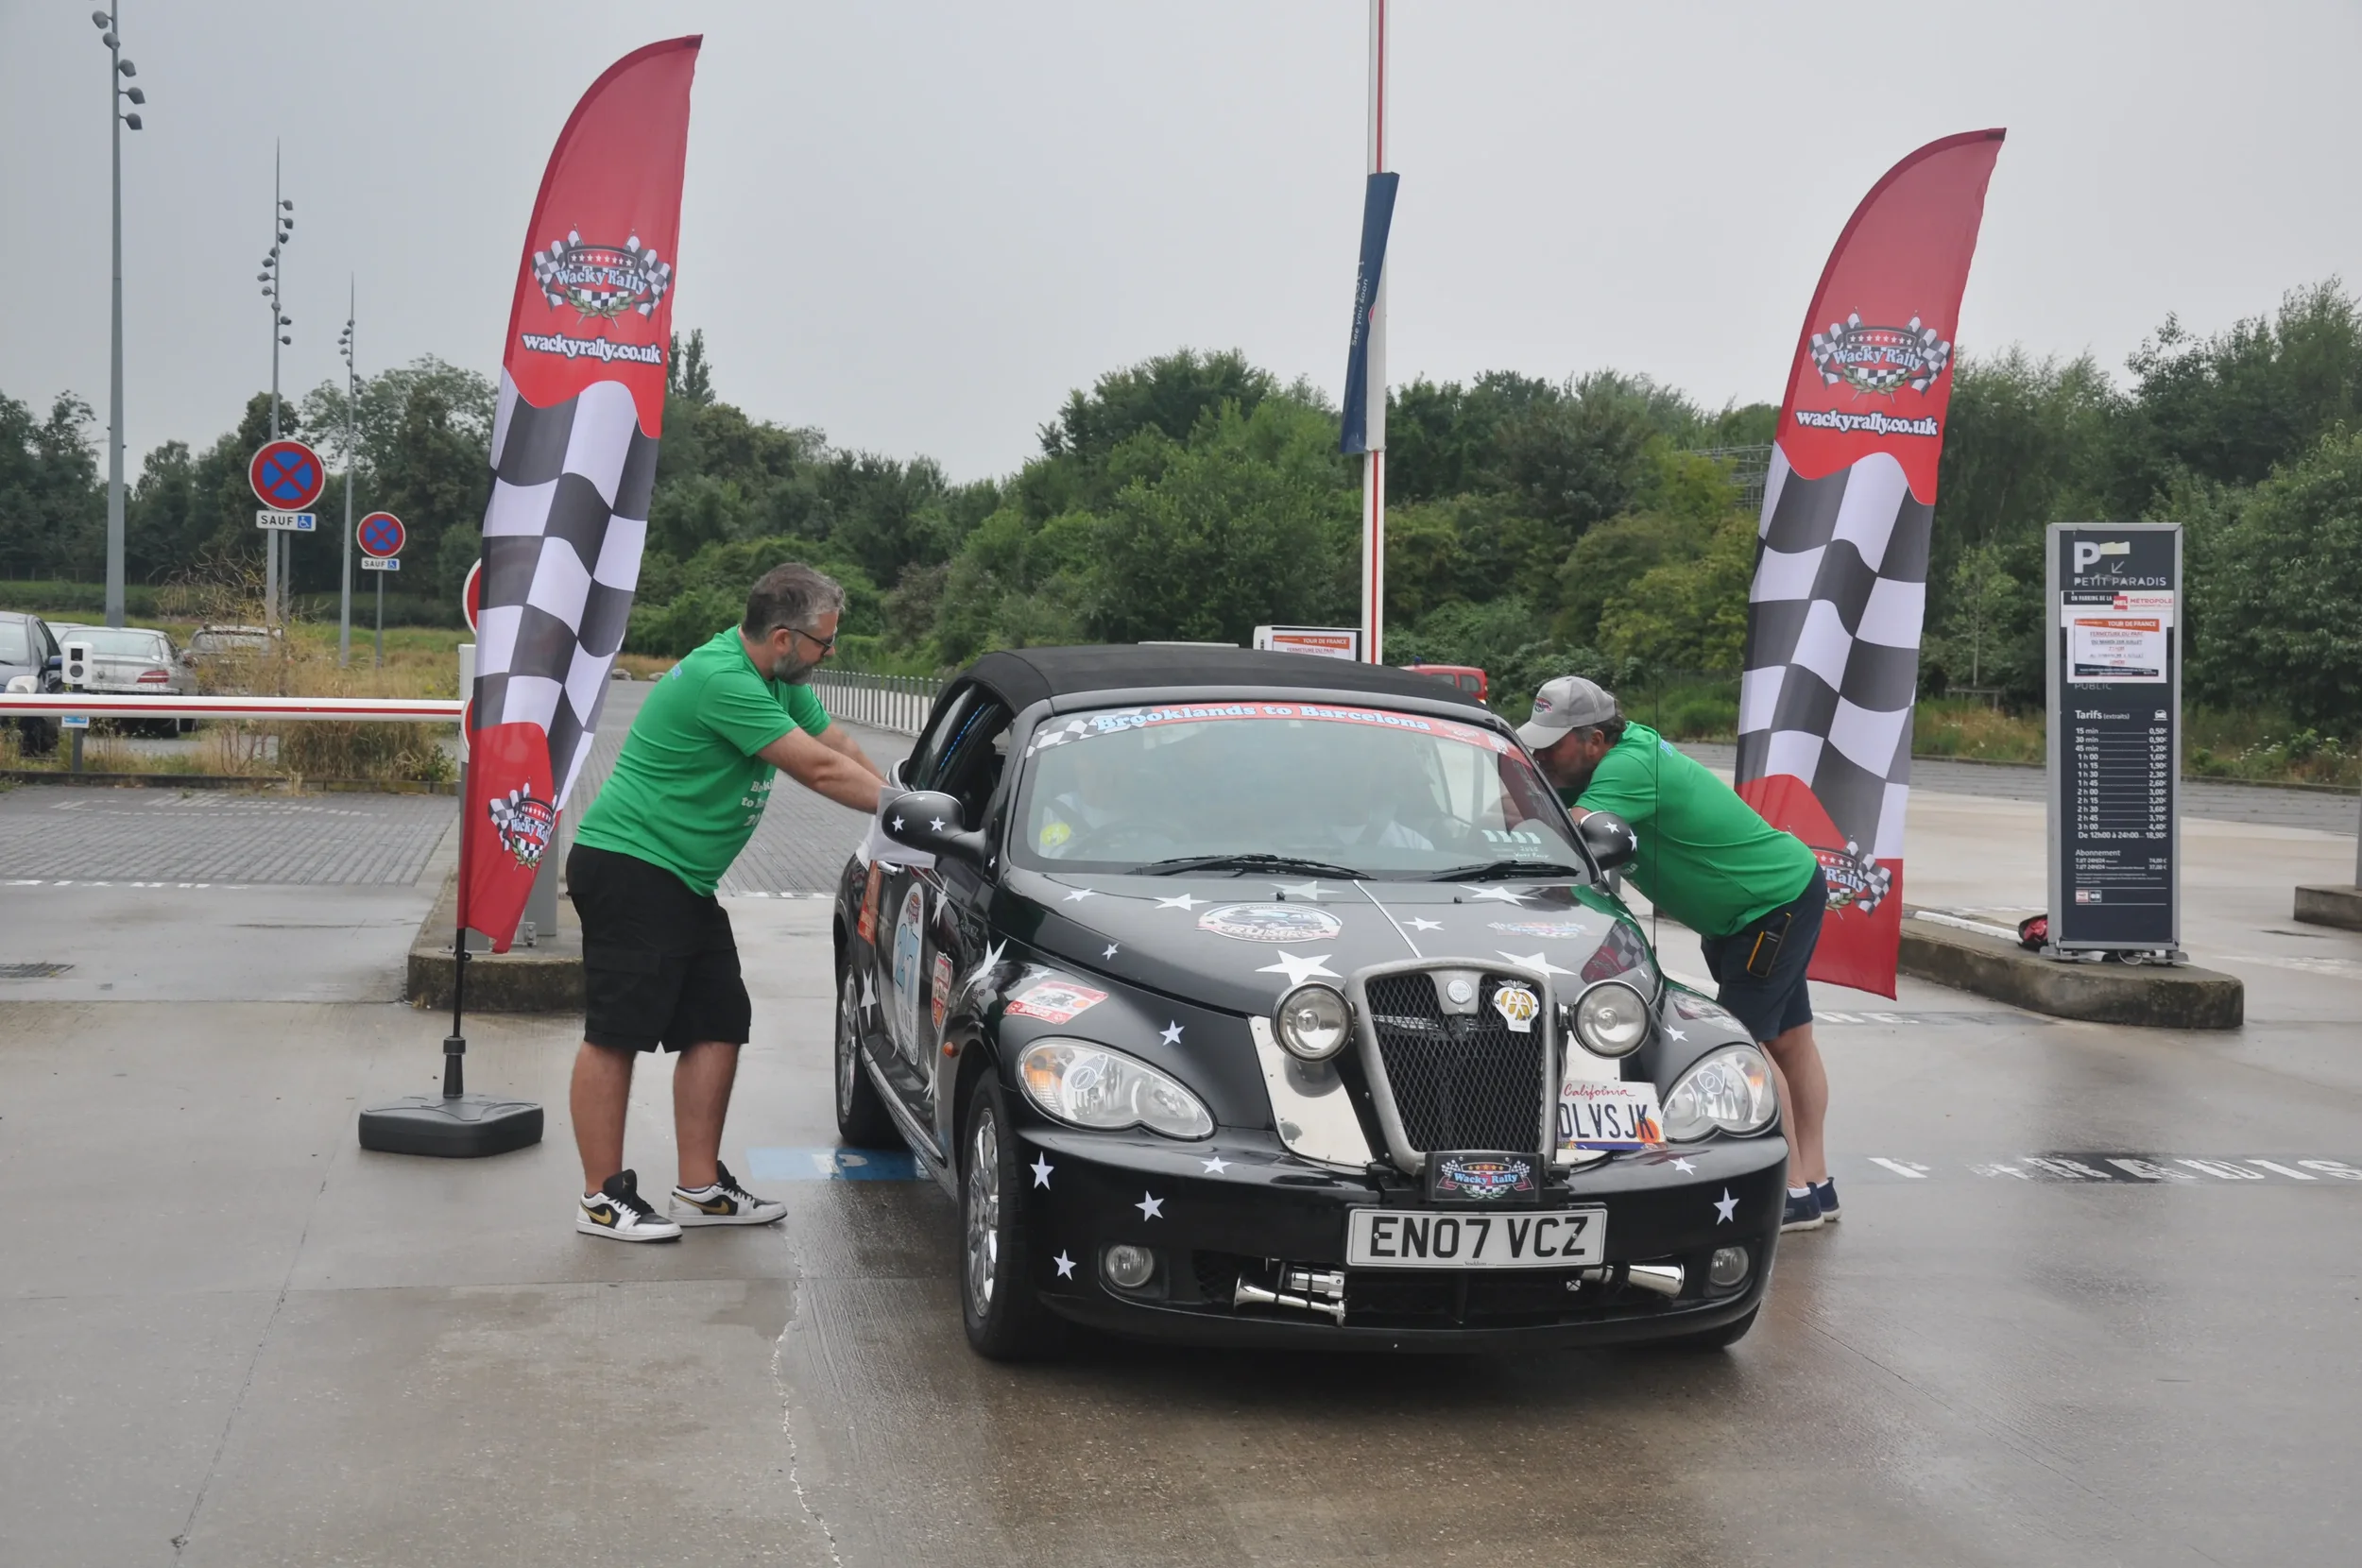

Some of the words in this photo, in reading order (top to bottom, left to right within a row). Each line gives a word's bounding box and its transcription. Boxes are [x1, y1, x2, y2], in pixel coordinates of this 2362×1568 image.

[556, 266, 606, 286] Wacky
[608, 268, 647, 295] Rally
[1360, 279, 1369, 303] soon
[522, 333, 661, 365] wackyrally.co.uk
[1832, 348, 1884, 365] Wacky
[1885, 349, 1925, 370] Rally
[1796, 411, 1938, 436] wackyrally.co.uk
[261, 515, 294, 526] SAUF
[2074, 541, 2102, 574] P
[2074, 577, 2109, 586] PETIT
[2113, 577, 2166, 586] PARADIS
[1096, 706, 1257, 731] Brooklands
[1262, 706, 1293, 715] to
[1298, 706, 1430, 730] Barcelona
[2075, 710, 2102, 720] Tarifs
[742, 797, 754, 808] to
[1826, 868, 1867, 893] Rally
[1564, 1083, 1635, 1099] California
[1454, 1172, 1488, 1185] Wacky
[1491, 1173, 1518, 1184] Rally
[1370, 1217, 1491, 1258] EN07
[1507, 1217, 1588, 1258] VCZ
